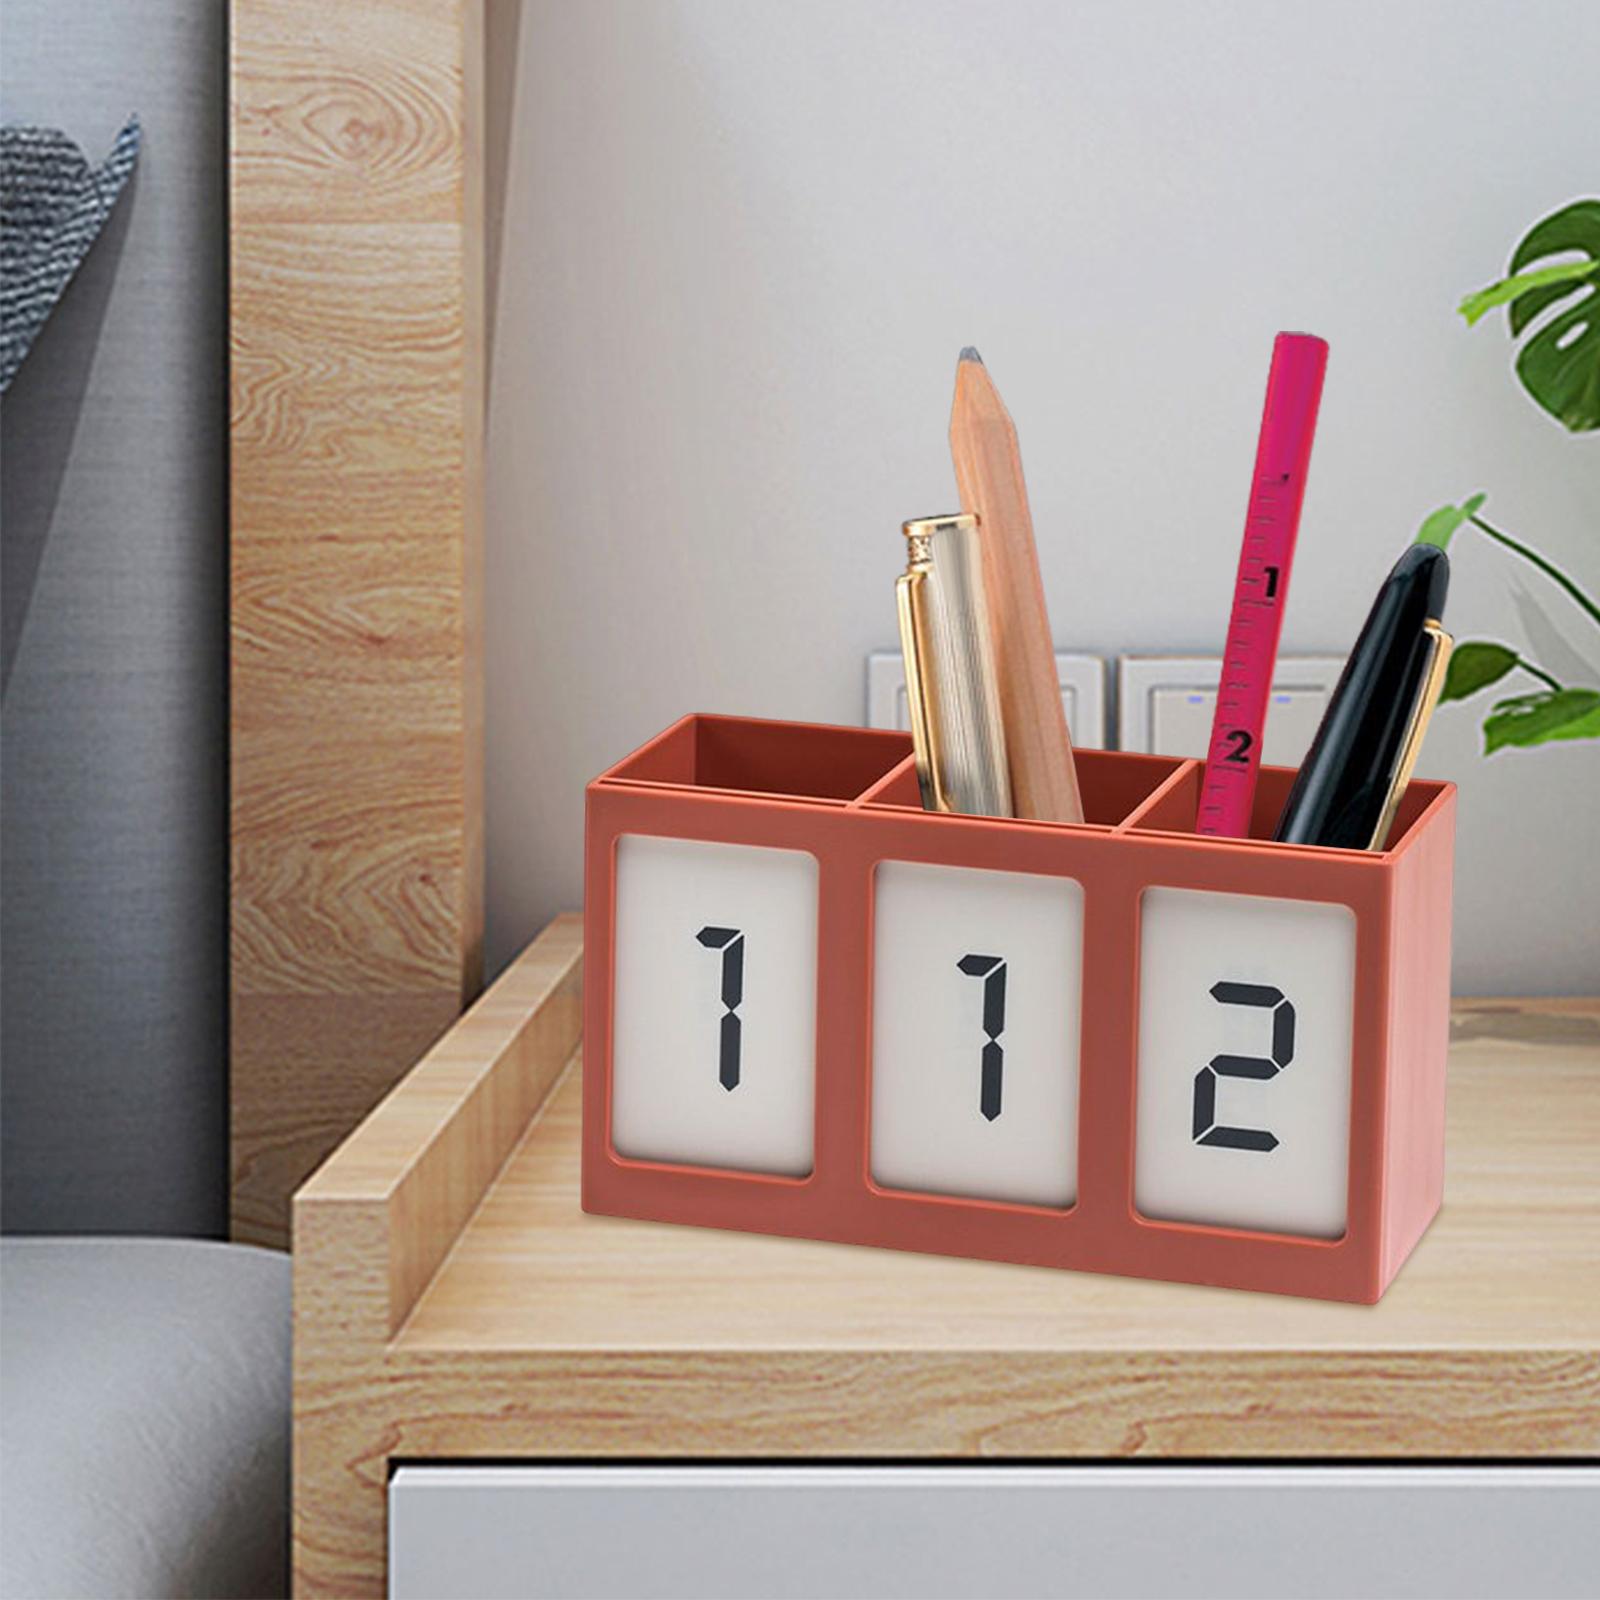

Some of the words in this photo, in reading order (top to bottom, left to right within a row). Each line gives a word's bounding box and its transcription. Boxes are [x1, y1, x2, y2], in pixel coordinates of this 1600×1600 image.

[1263, 567, 1280, 598] 1
[1225, 731, 1253, 763] 2
[695, 926, 745, 1092] 1
[956, 954, 1007, 1122] 1
[1192, 981, 1296, 1153] 2
